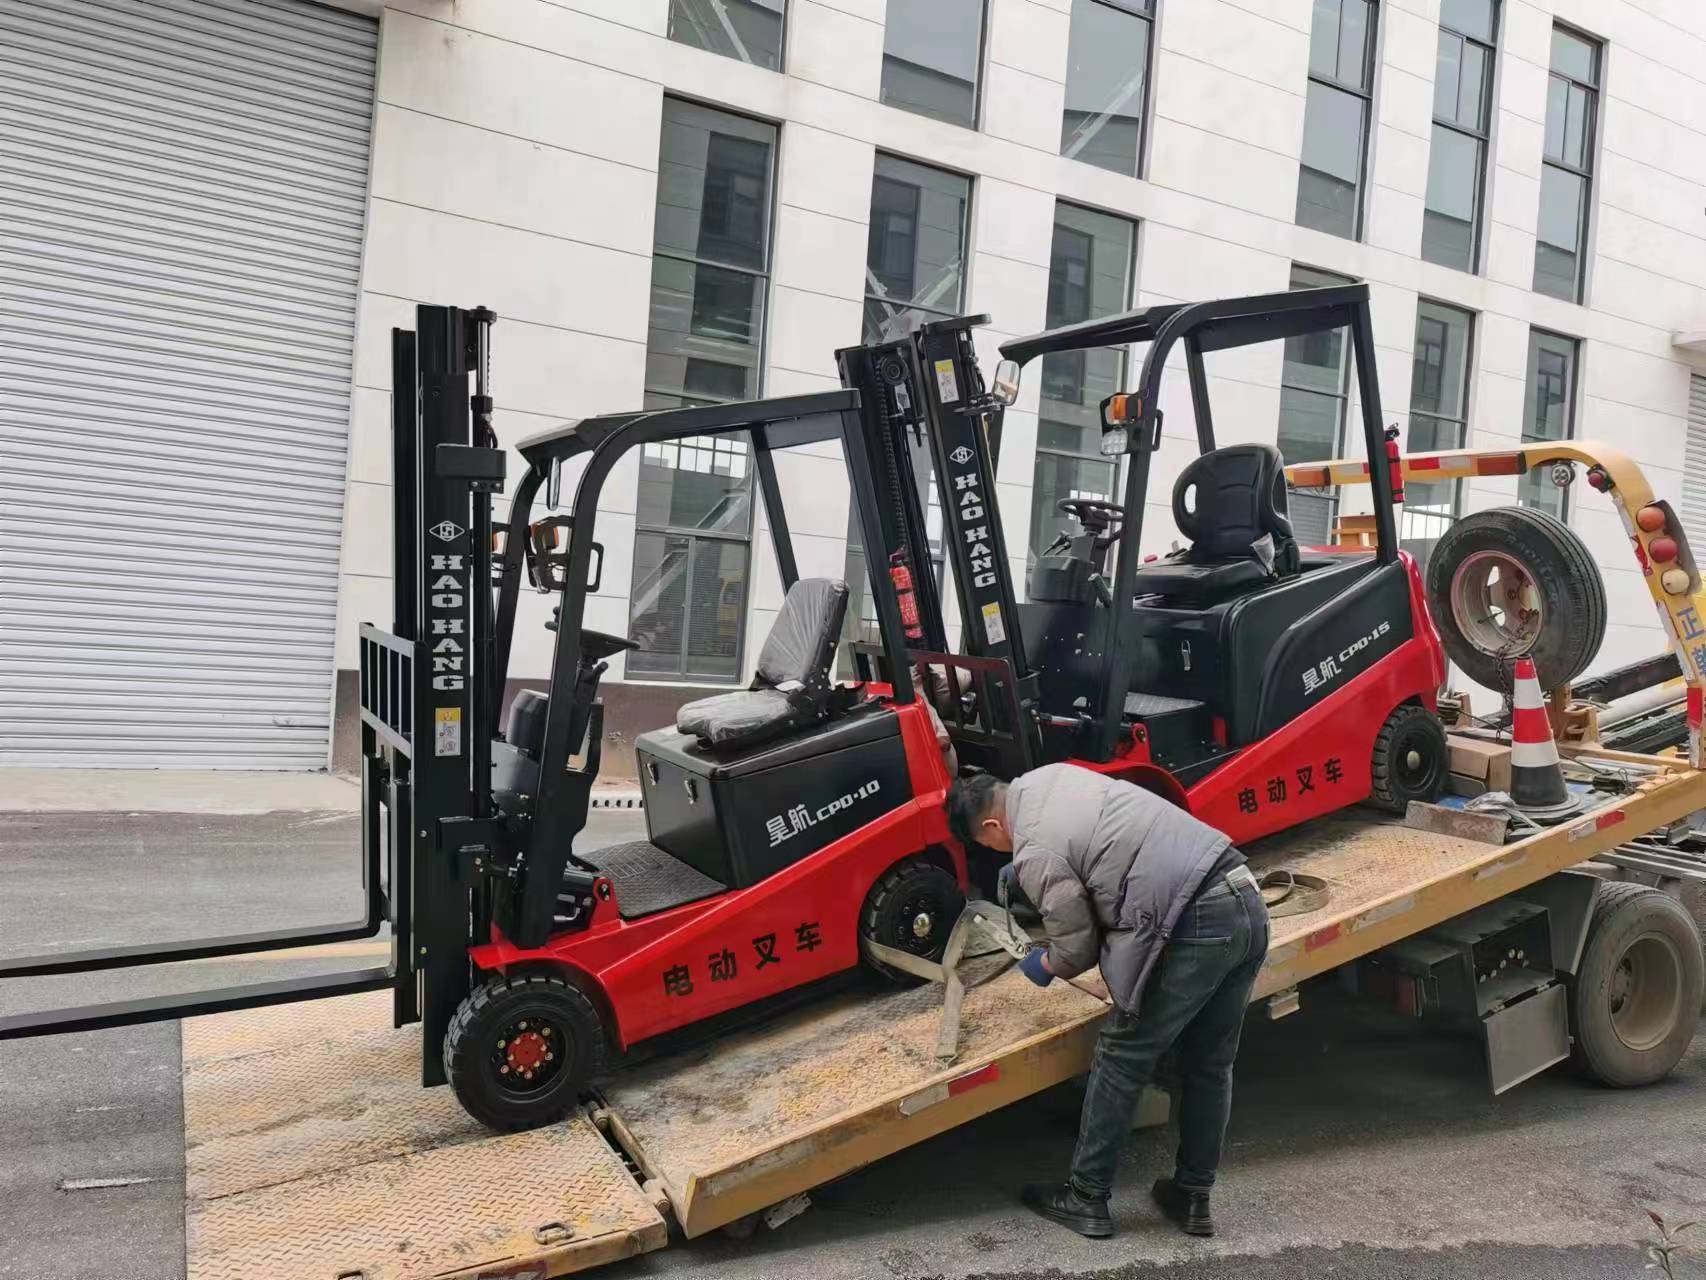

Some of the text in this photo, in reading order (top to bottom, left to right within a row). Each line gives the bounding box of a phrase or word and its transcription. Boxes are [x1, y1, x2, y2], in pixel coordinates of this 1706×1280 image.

[955, 473, 996, 587] HAO HANG
[431, 555, 464, 690] HAO HANG
[1238, 757, 1344, 814] 电动叉车
[663, 922, 822, 997] 电动叉车
